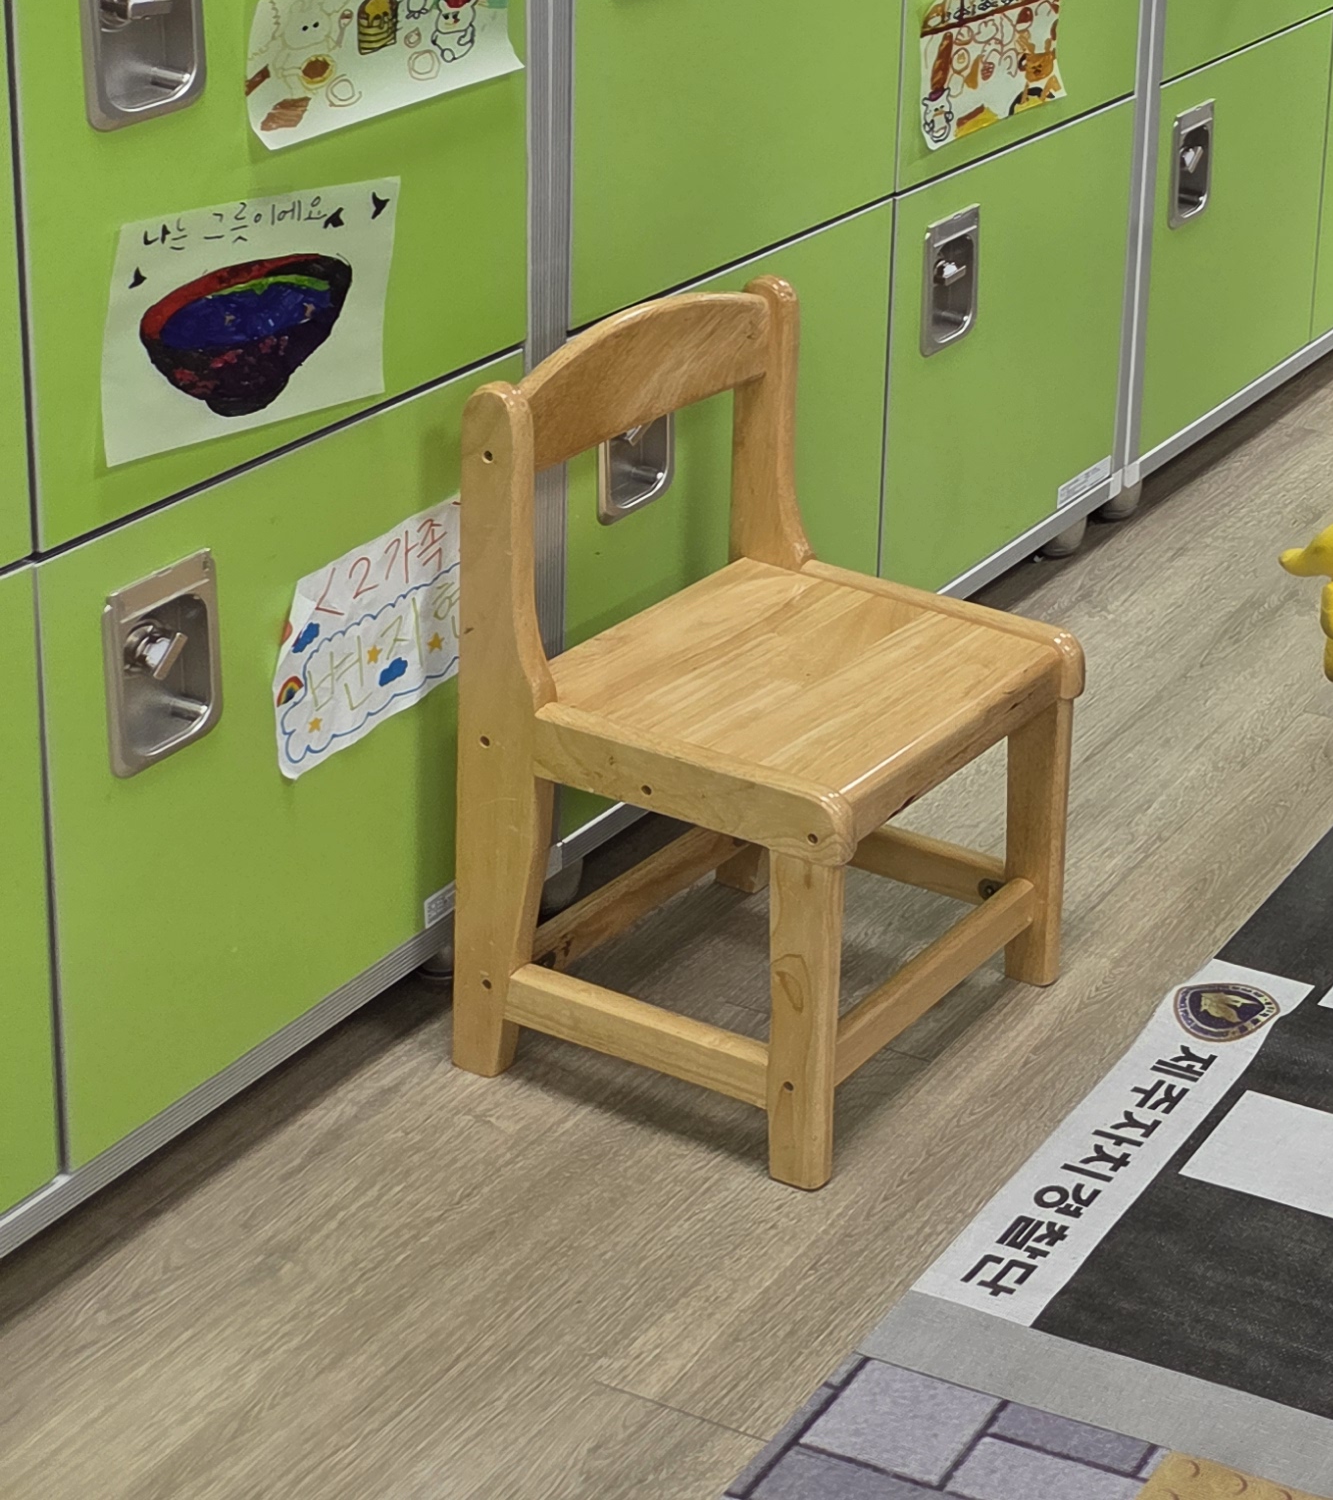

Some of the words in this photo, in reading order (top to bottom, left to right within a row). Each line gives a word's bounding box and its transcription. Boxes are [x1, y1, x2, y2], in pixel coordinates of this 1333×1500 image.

[142, 217, 189, 251] 나는
[203, 195, 327, 244] 그릇이에요
[959, 1044, 1219, 1297] 제주자치경찰단
